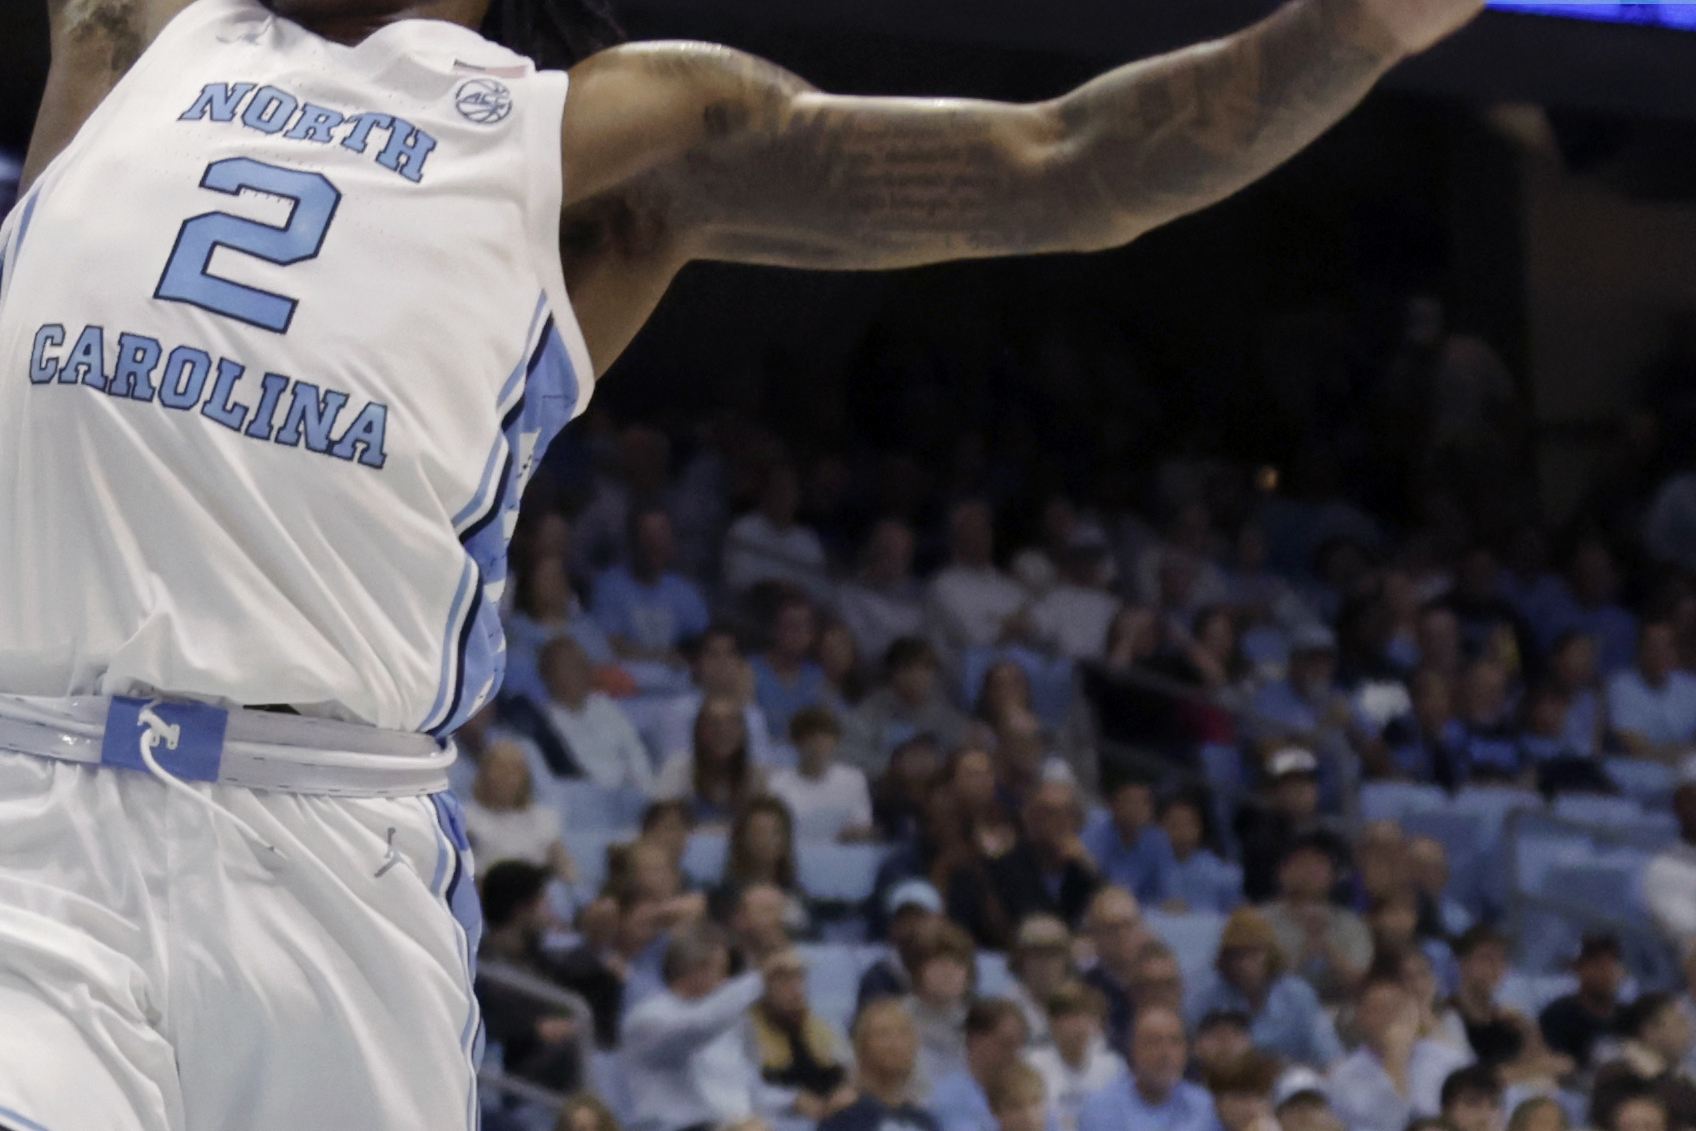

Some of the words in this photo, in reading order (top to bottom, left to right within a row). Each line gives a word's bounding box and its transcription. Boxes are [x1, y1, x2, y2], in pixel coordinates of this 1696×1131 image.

[178, 82, 436, 183] NORTH
[153, 156, 342, 334] 2
[29, 323, 387, 470] CAROLINA
